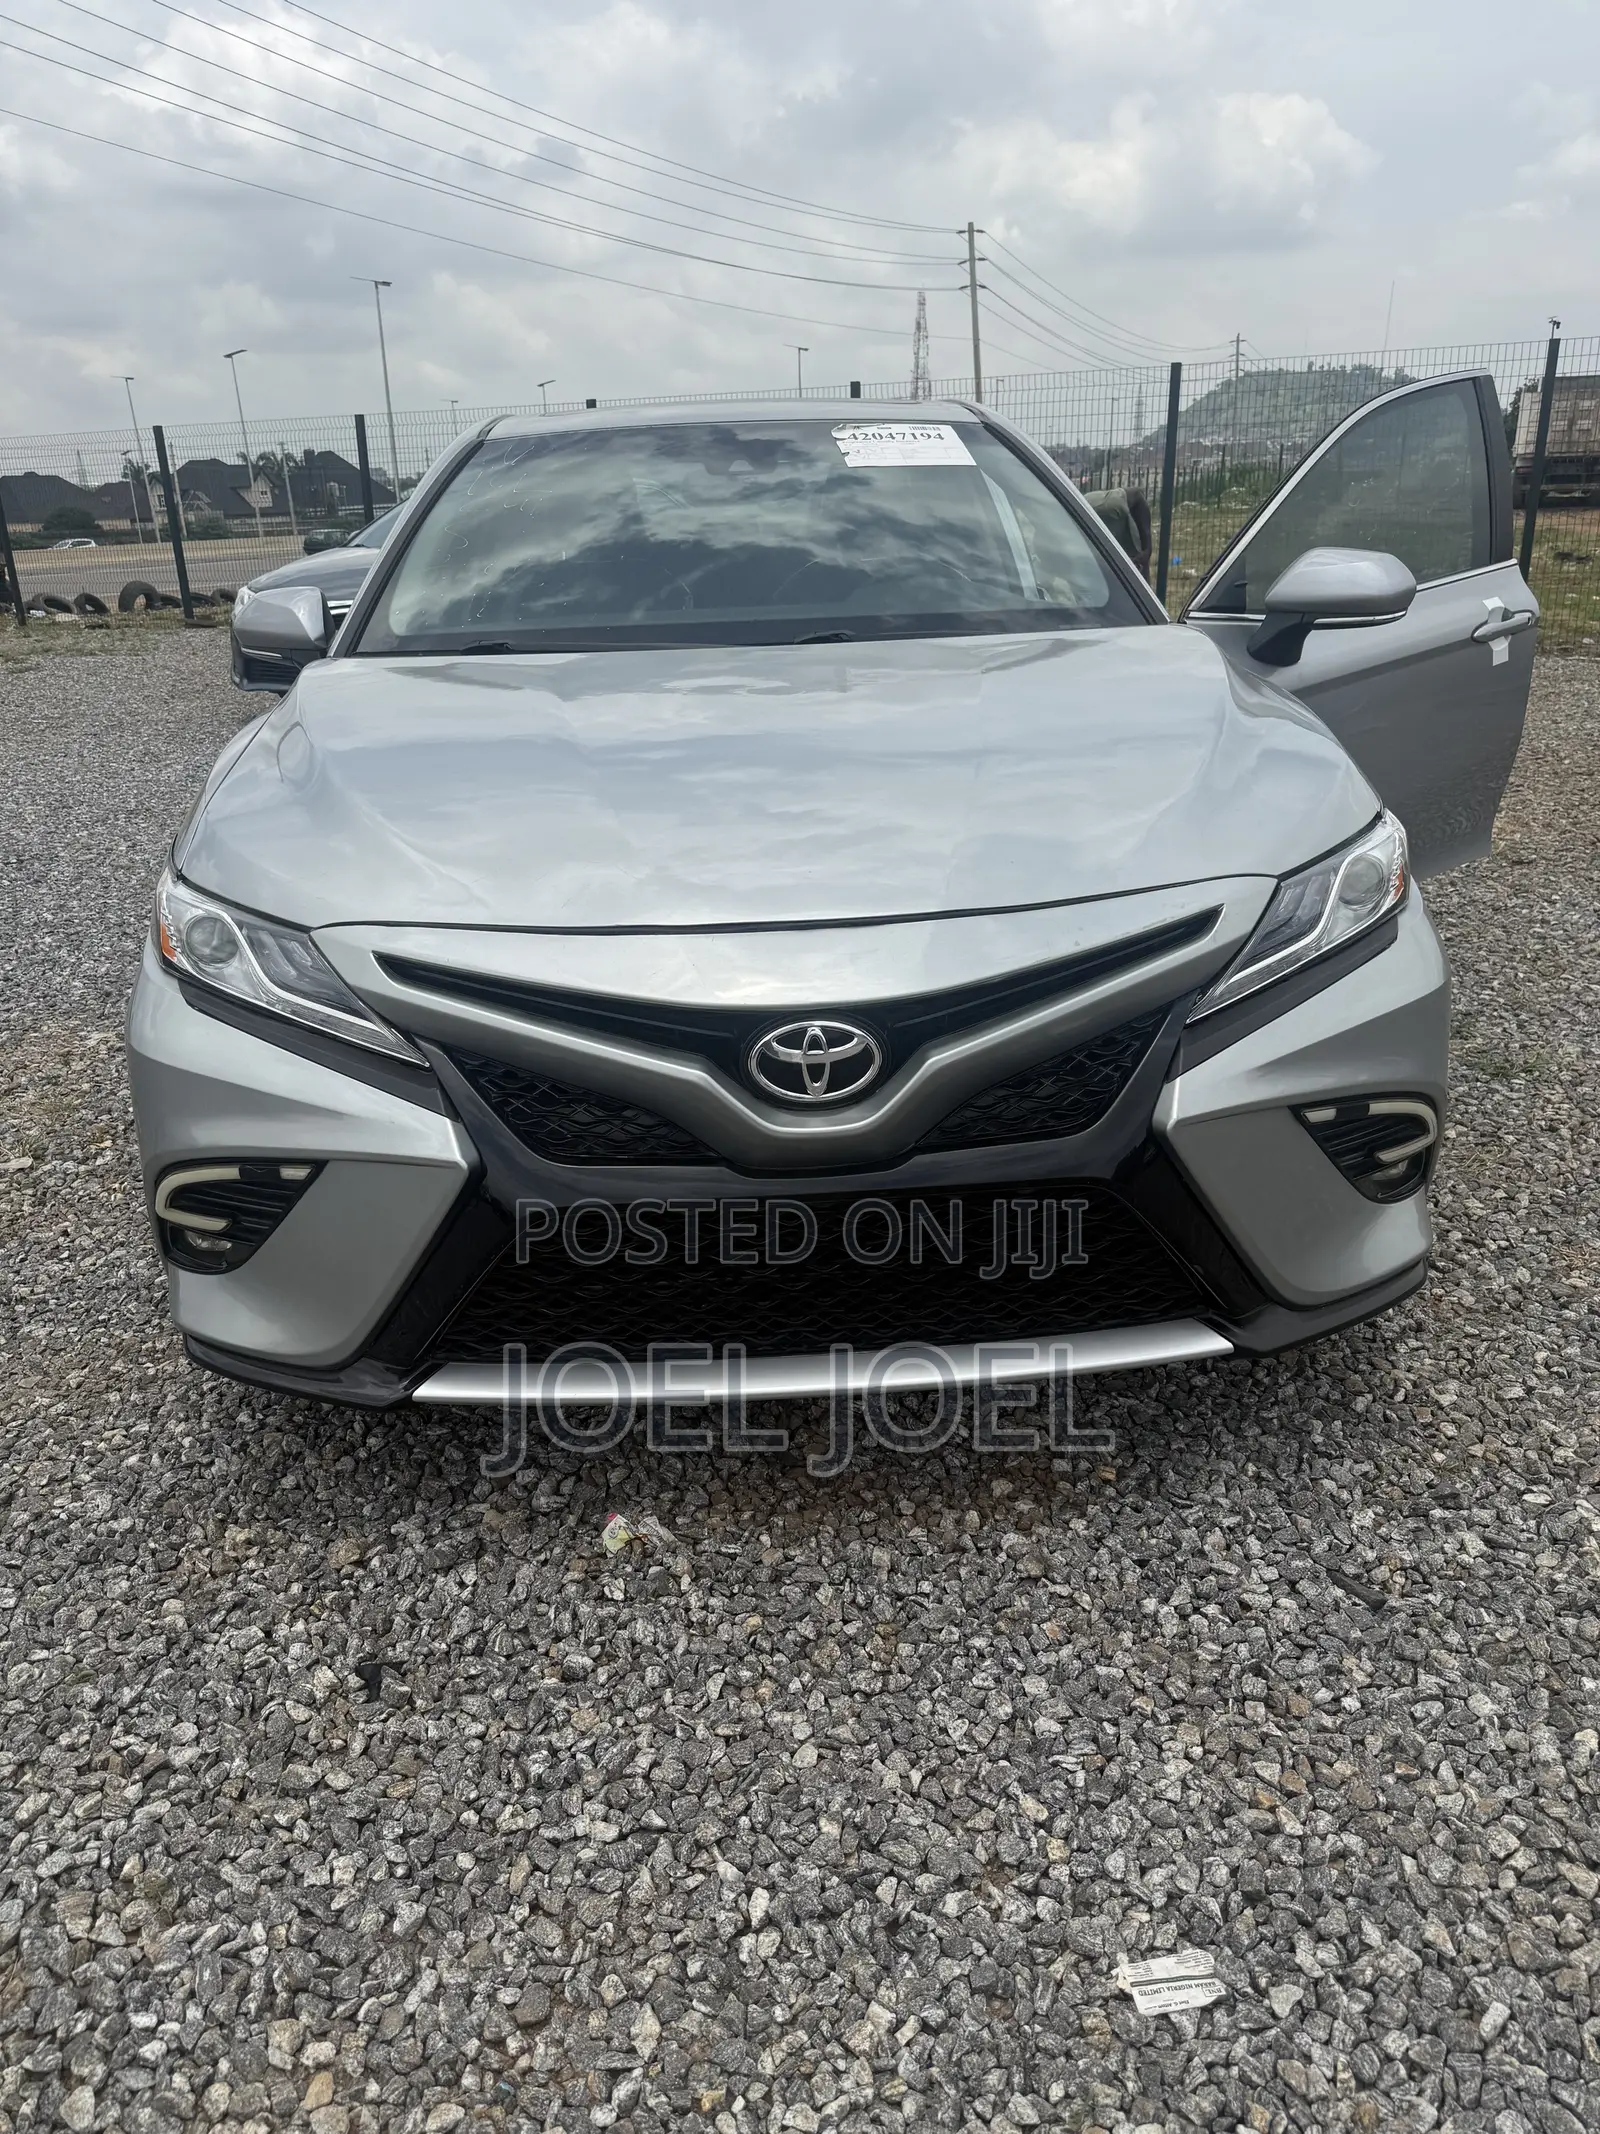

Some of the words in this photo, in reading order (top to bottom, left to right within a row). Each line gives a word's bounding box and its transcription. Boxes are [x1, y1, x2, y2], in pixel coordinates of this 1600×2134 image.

[847, 432, 945, 441] 42047194
[1138, 1987, 1165, 1996] LIMITED
[1165, 1984, 1193, 1992] NIGERIA
